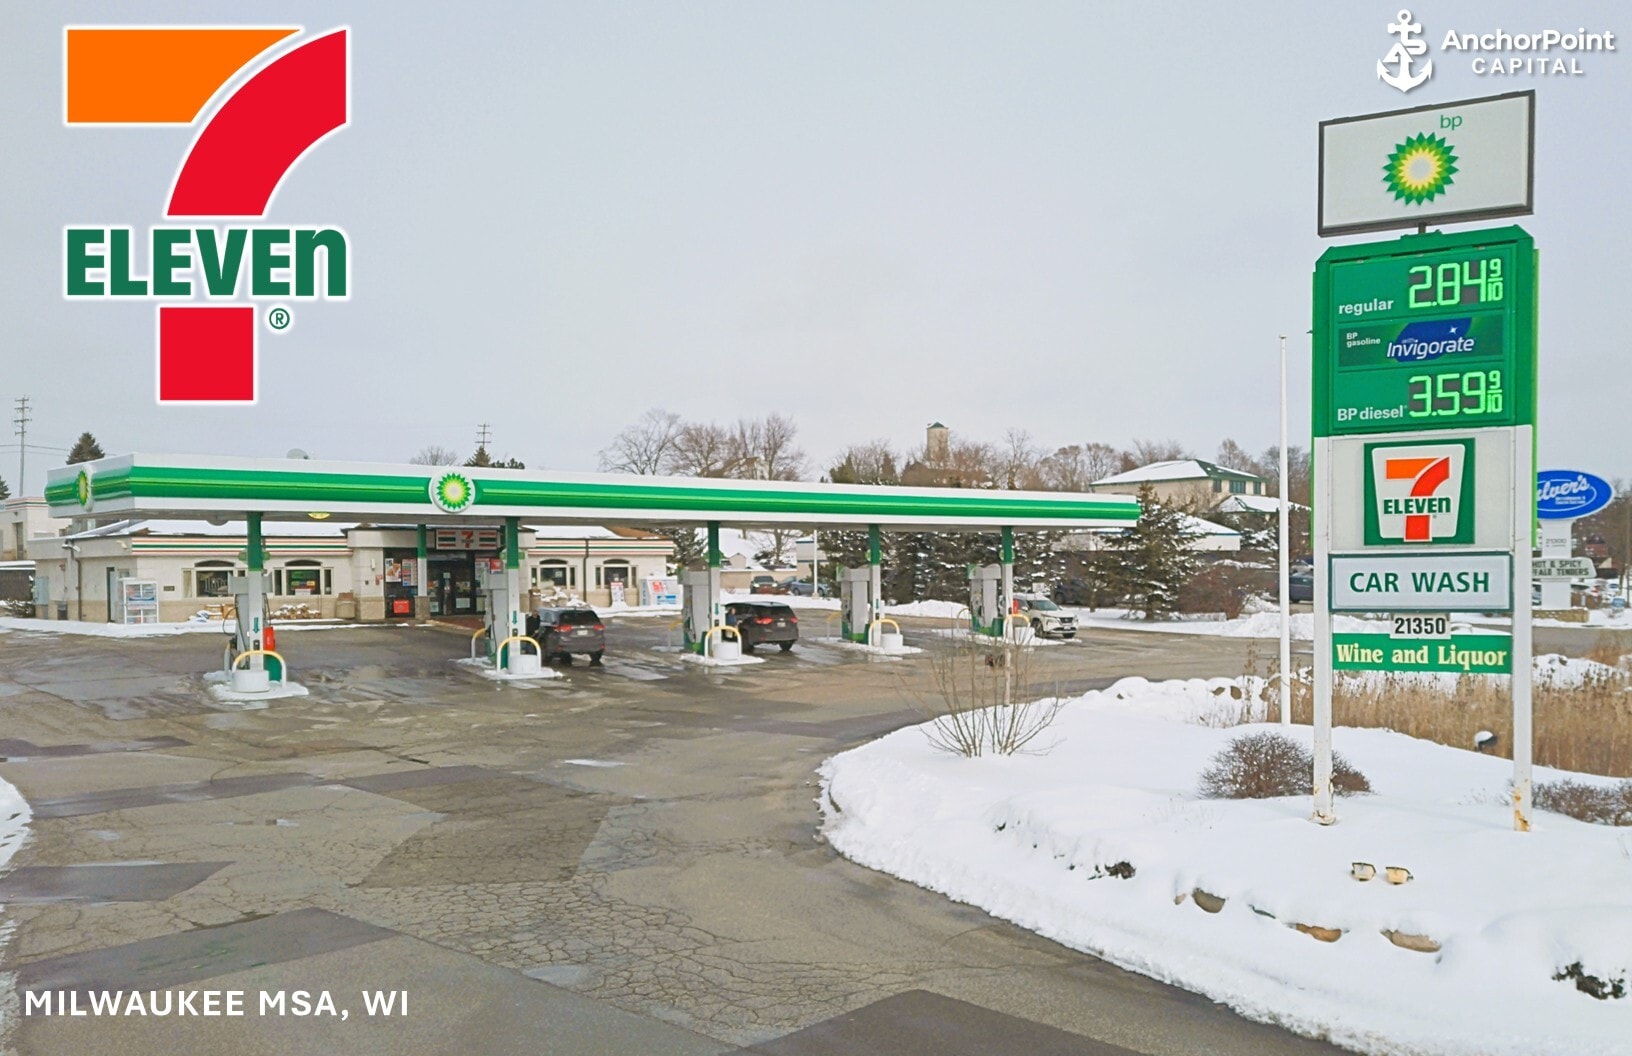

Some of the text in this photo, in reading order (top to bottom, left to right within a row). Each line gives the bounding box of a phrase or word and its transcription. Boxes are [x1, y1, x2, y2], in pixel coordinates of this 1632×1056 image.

[1440, 114, 1463, 131] bp
[1338, 299, 1394, 316] regular
[1346, 332, 1358, 340] BP
[1346, 338, 1381, 348] gasoline
[1386, 337, 1475, 359] Invigorate
[1337, 404, 1404, 421] BP diesel
[1559, 560, 1583, 568] SPICY
[1349, 572, 1490, 593] CAR WASH
[1394, 617, 1446, 635] 21350
[1336, 643, 1507, 671] Wine and Liquor
